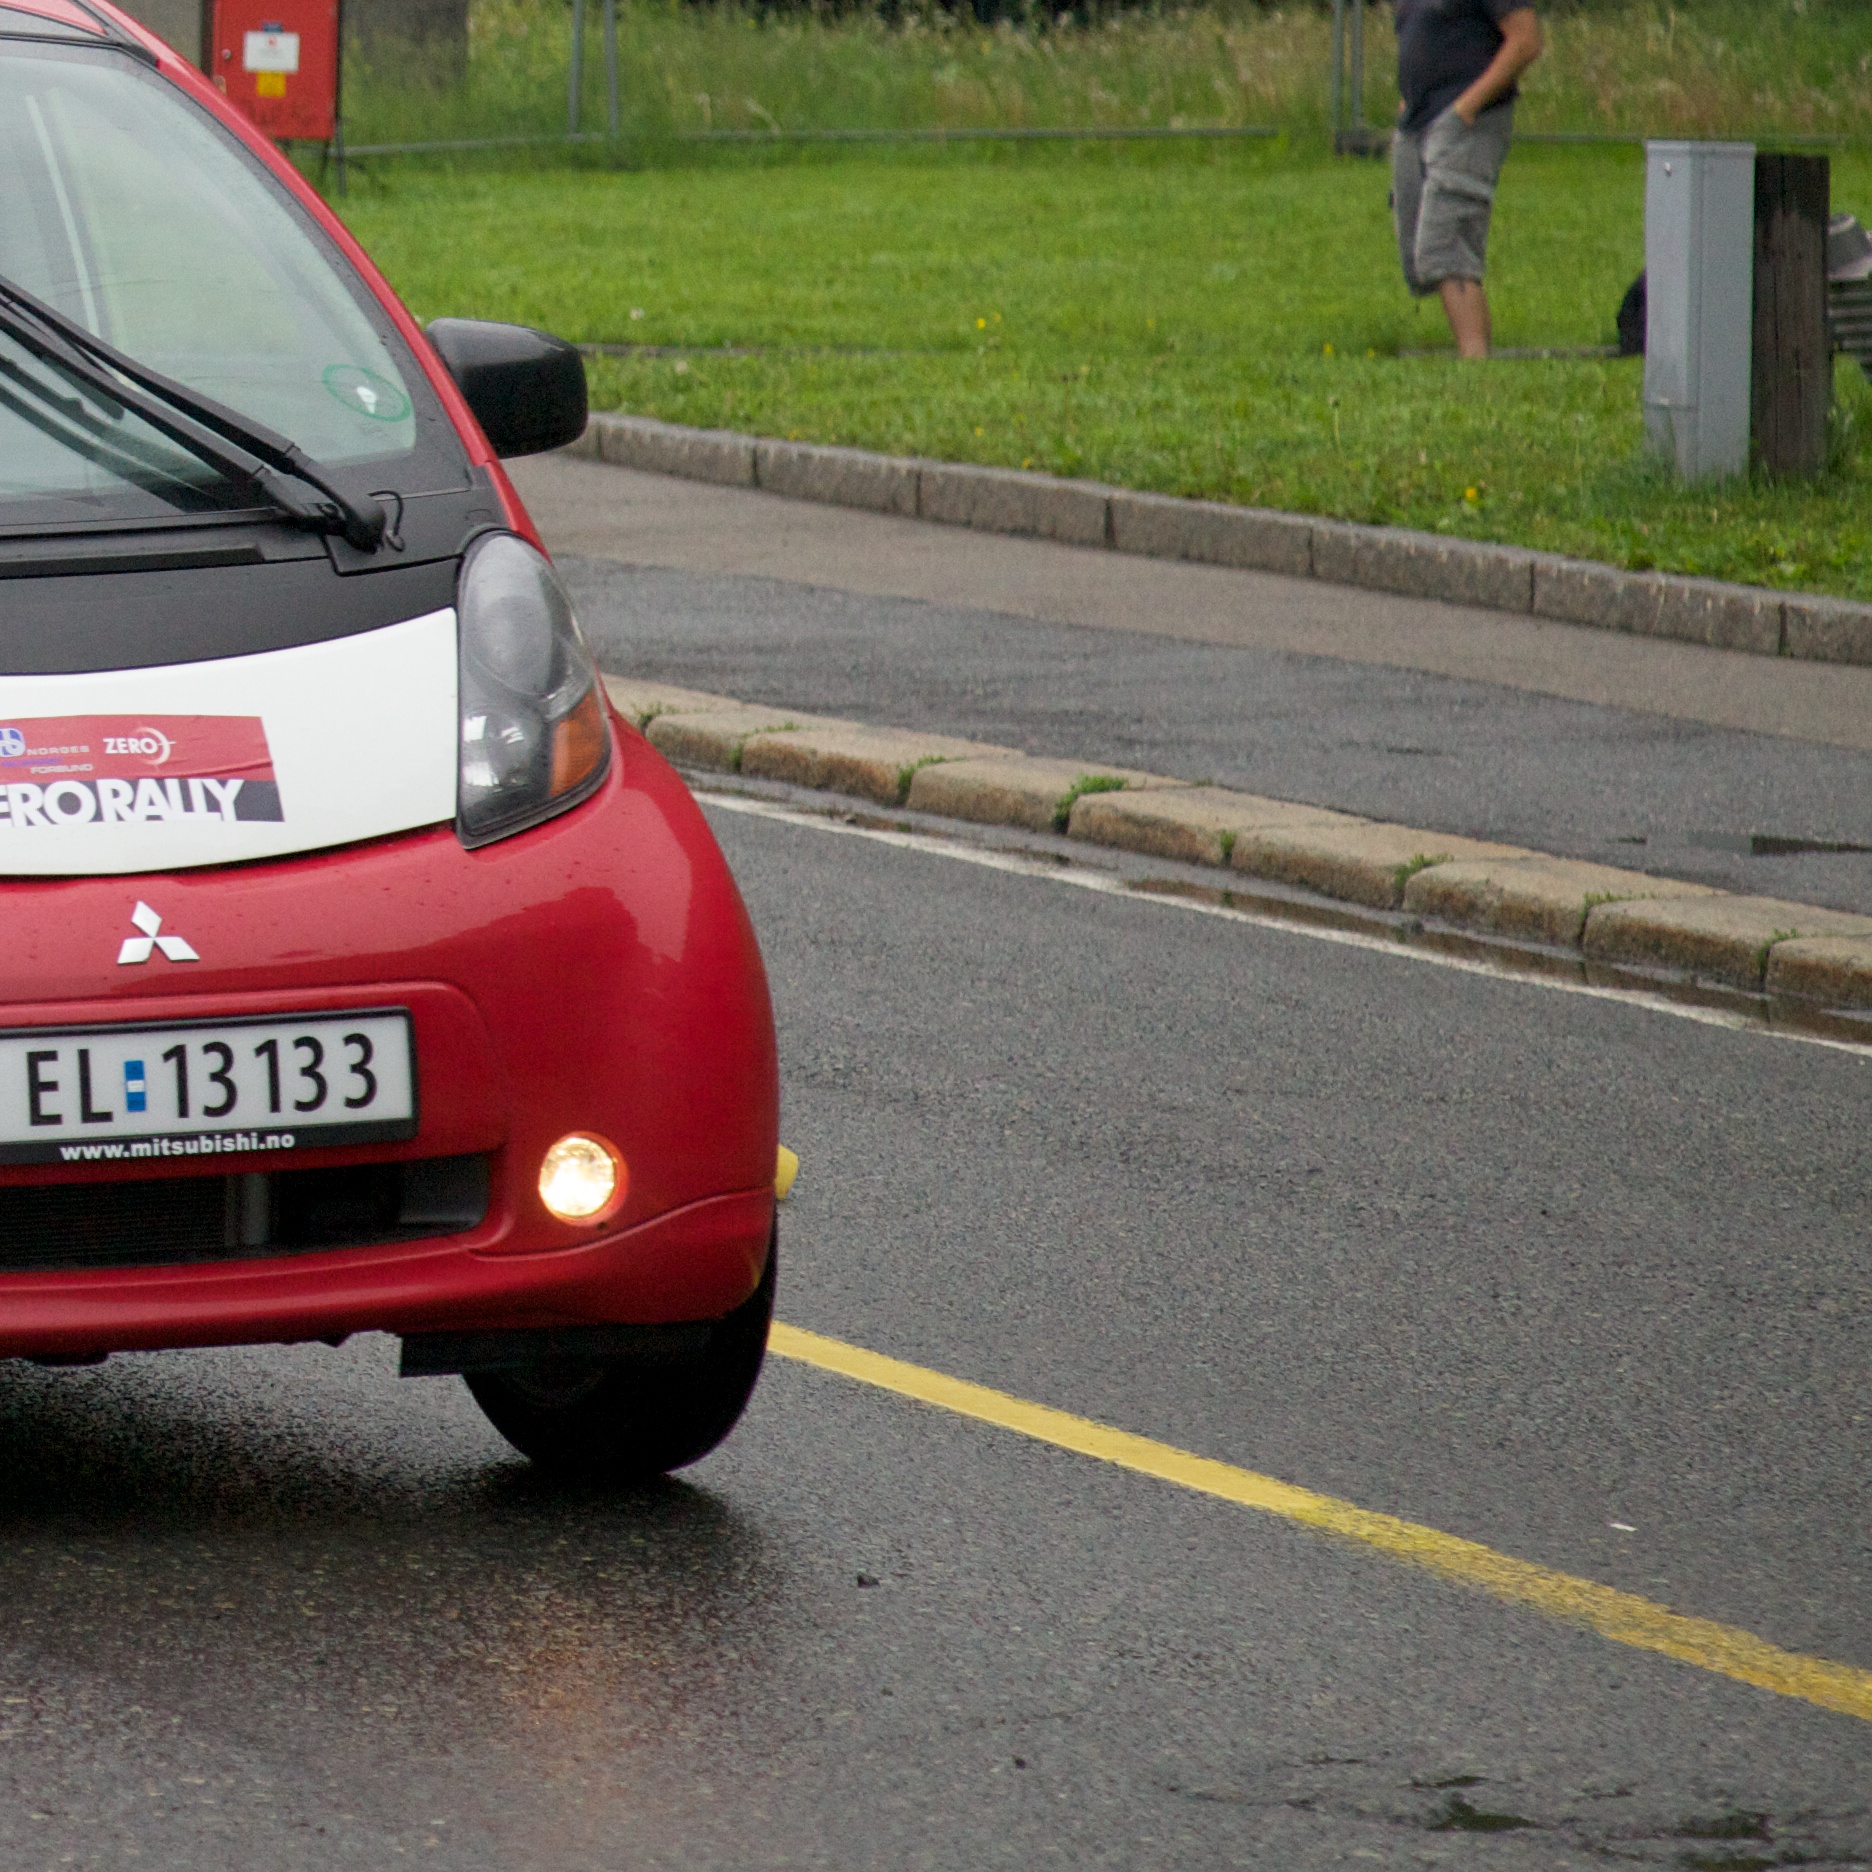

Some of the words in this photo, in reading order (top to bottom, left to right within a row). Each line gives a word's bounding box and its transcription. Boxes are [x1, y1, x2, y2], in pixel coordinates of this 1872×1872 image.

[27, 745, 90, 757] NORGES
[102, 737, 158, 756] ZERO
[30, 763, 94, 775] FORBUND
[26, 1048, 114, 1128] EL
[161, 1032, 379, 1120] 13133
[60, 1132, 296, 1162] www.mitsubishi.no
